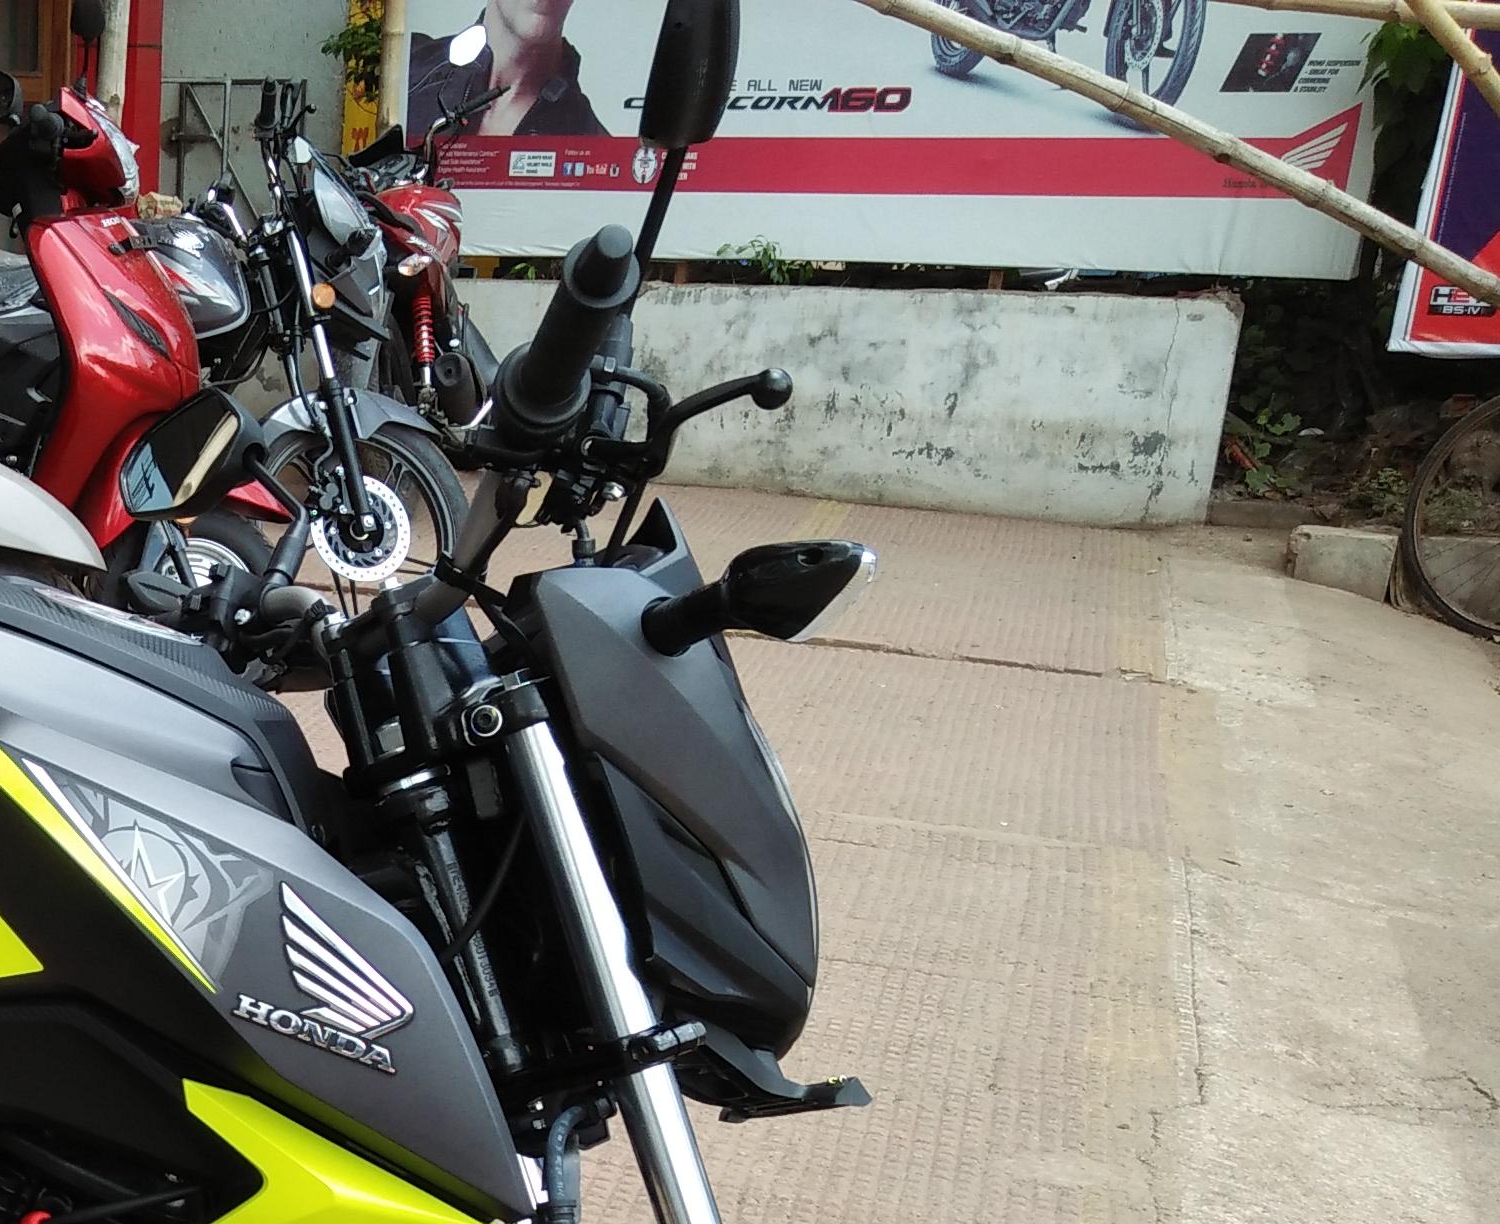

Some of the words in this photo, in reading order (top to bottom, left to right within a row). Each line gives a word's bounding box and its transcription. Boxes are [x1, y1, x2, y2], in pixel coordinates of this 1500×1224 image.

[747, 79, 777, 92] ALL
[788, 79, 823, 92] NEW
[232, 993, 396, 1075] HONDA
